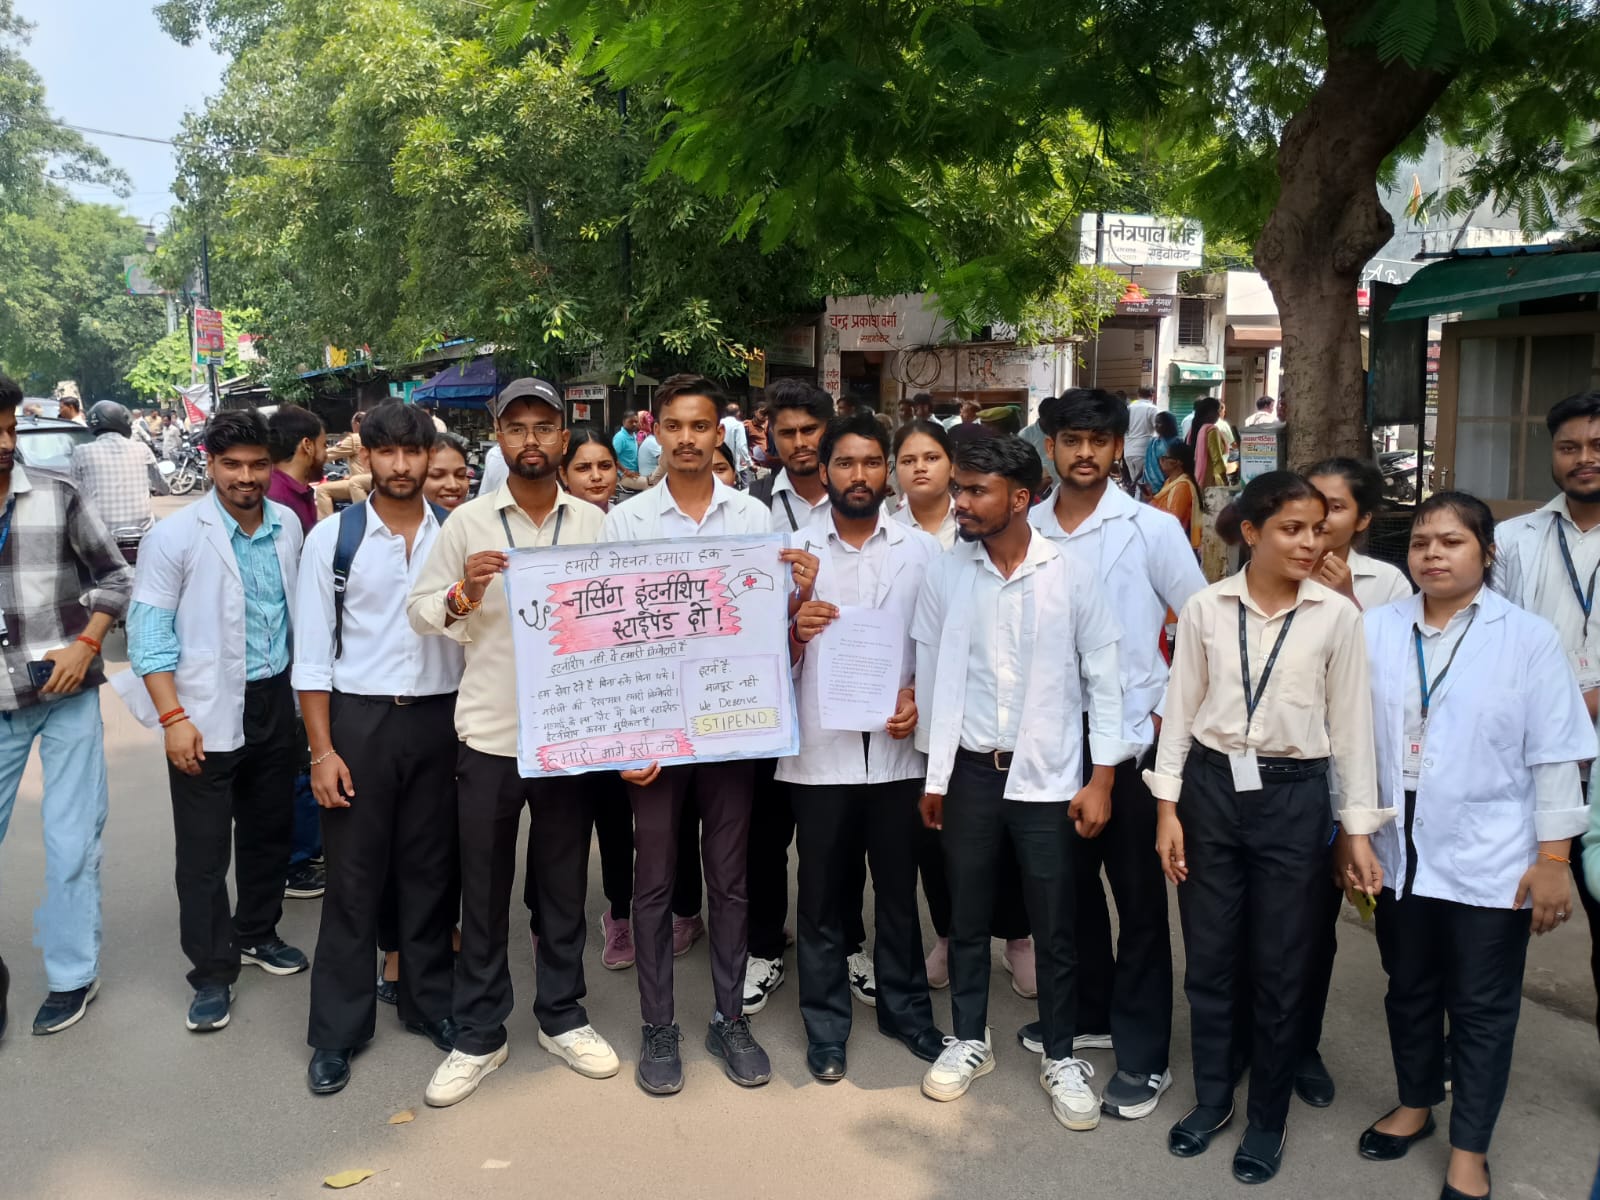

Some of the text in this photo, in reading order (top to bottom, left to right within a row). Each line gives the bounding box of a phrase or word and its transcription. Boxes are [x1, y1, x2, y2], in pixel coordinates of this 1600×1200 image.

[1111, 219, 1166, 242] नेत्रपाल
[829, 312, 897, 330] चन्द्र प्रकाश वर्मा
[565, 551, 603, 574] हमारी
[655, 551, 693, 565] हमारा
[698, 549, 722, 563] हक
[563, 572, 709, 614] नर्सिंग इंटर्नशिप
[620, 646, 644, 661] हमारी
[537, 689, 551, 700] हम
[554, 684, 571, 696] सेवा
[699, 696, 758, 711] We Deserve
[702, 711, 768, 732] STIPEND
